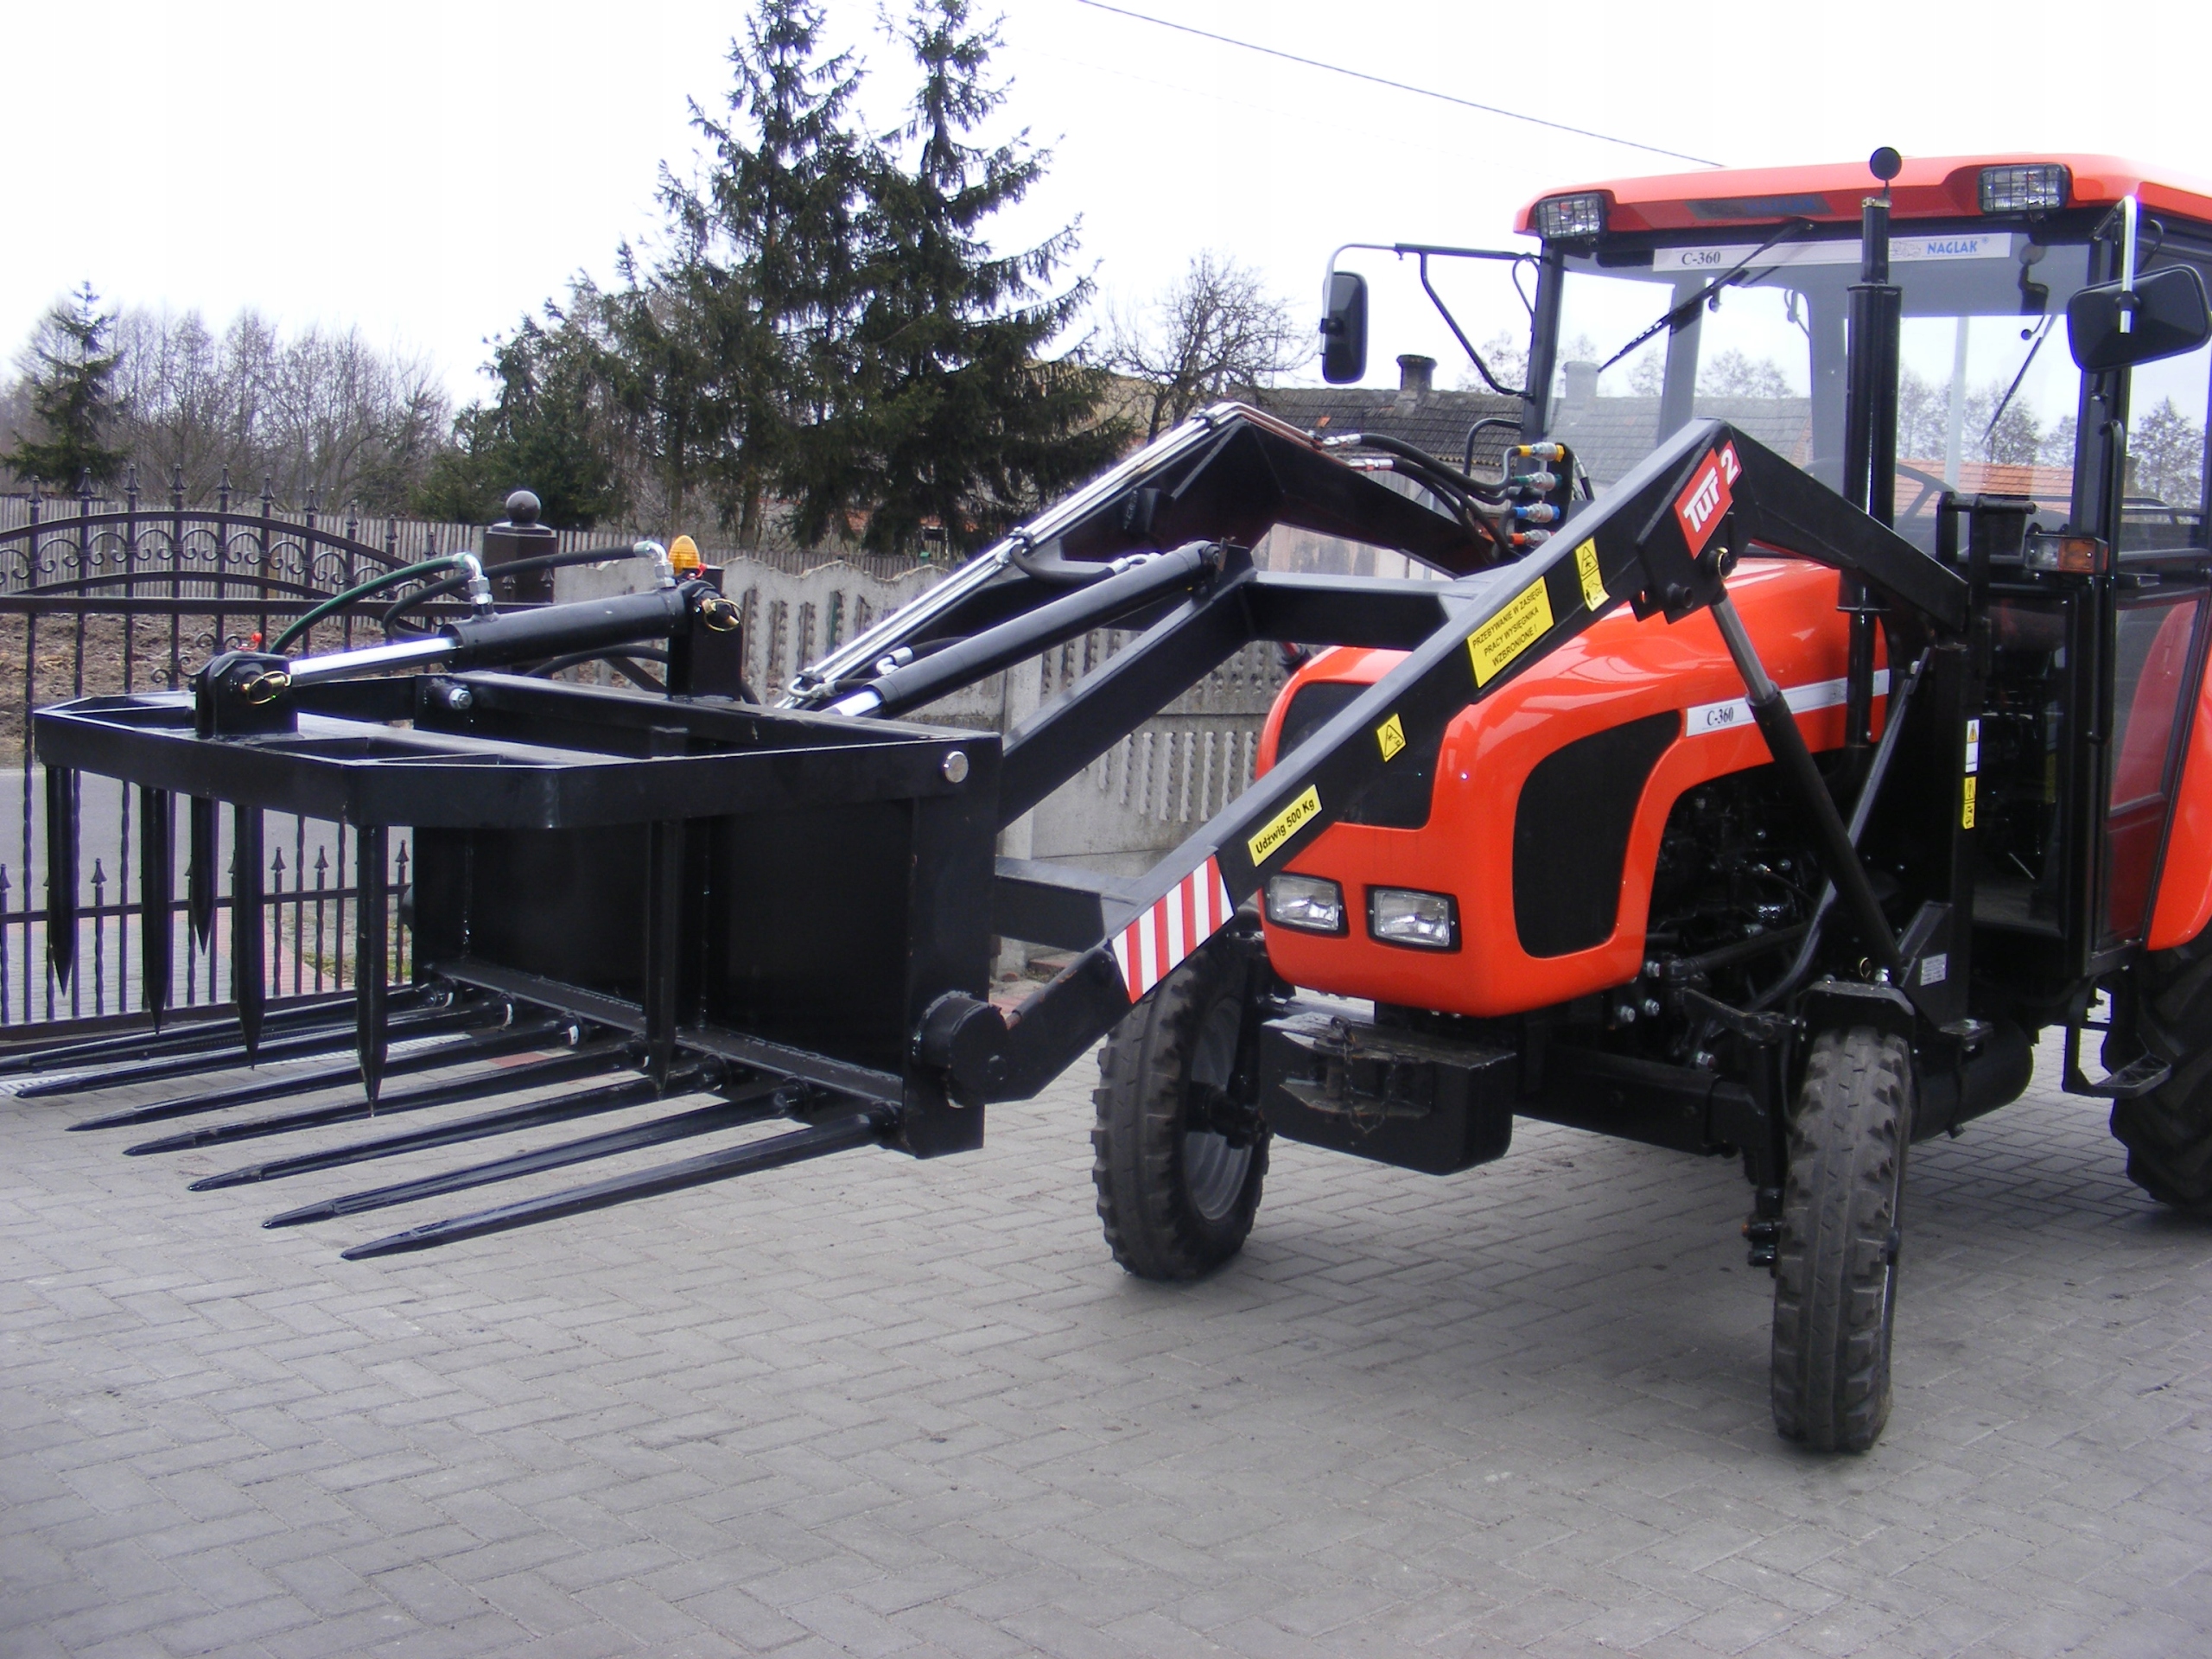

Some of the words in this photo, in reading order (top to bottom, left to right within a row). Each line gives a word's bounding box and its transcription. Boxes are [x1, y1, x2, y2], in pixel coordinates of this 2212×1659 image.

[1681, 251, 1721, 265] C-360
[1927, 240, 1978, 254] NAGLAK
[1720, 448, 1738, 485] 2
[1472, 611, 1513, 649] PRZEBYWANIE
[1513, 604, 1519, 615] W
[1519, 585, 1544, 610] ZASIĘGU
[1484, 634, 1504, 657] PRACY
[1503, 606, 1540, 640] WYSIĘGNIKA
[1491, 626, 1534, 667] WZBRONIONE
[1707, 706, 1734, 726] C-360
[1286, 808, 1302, 828] 500
[1302, 799, 1315, 814] Kg
